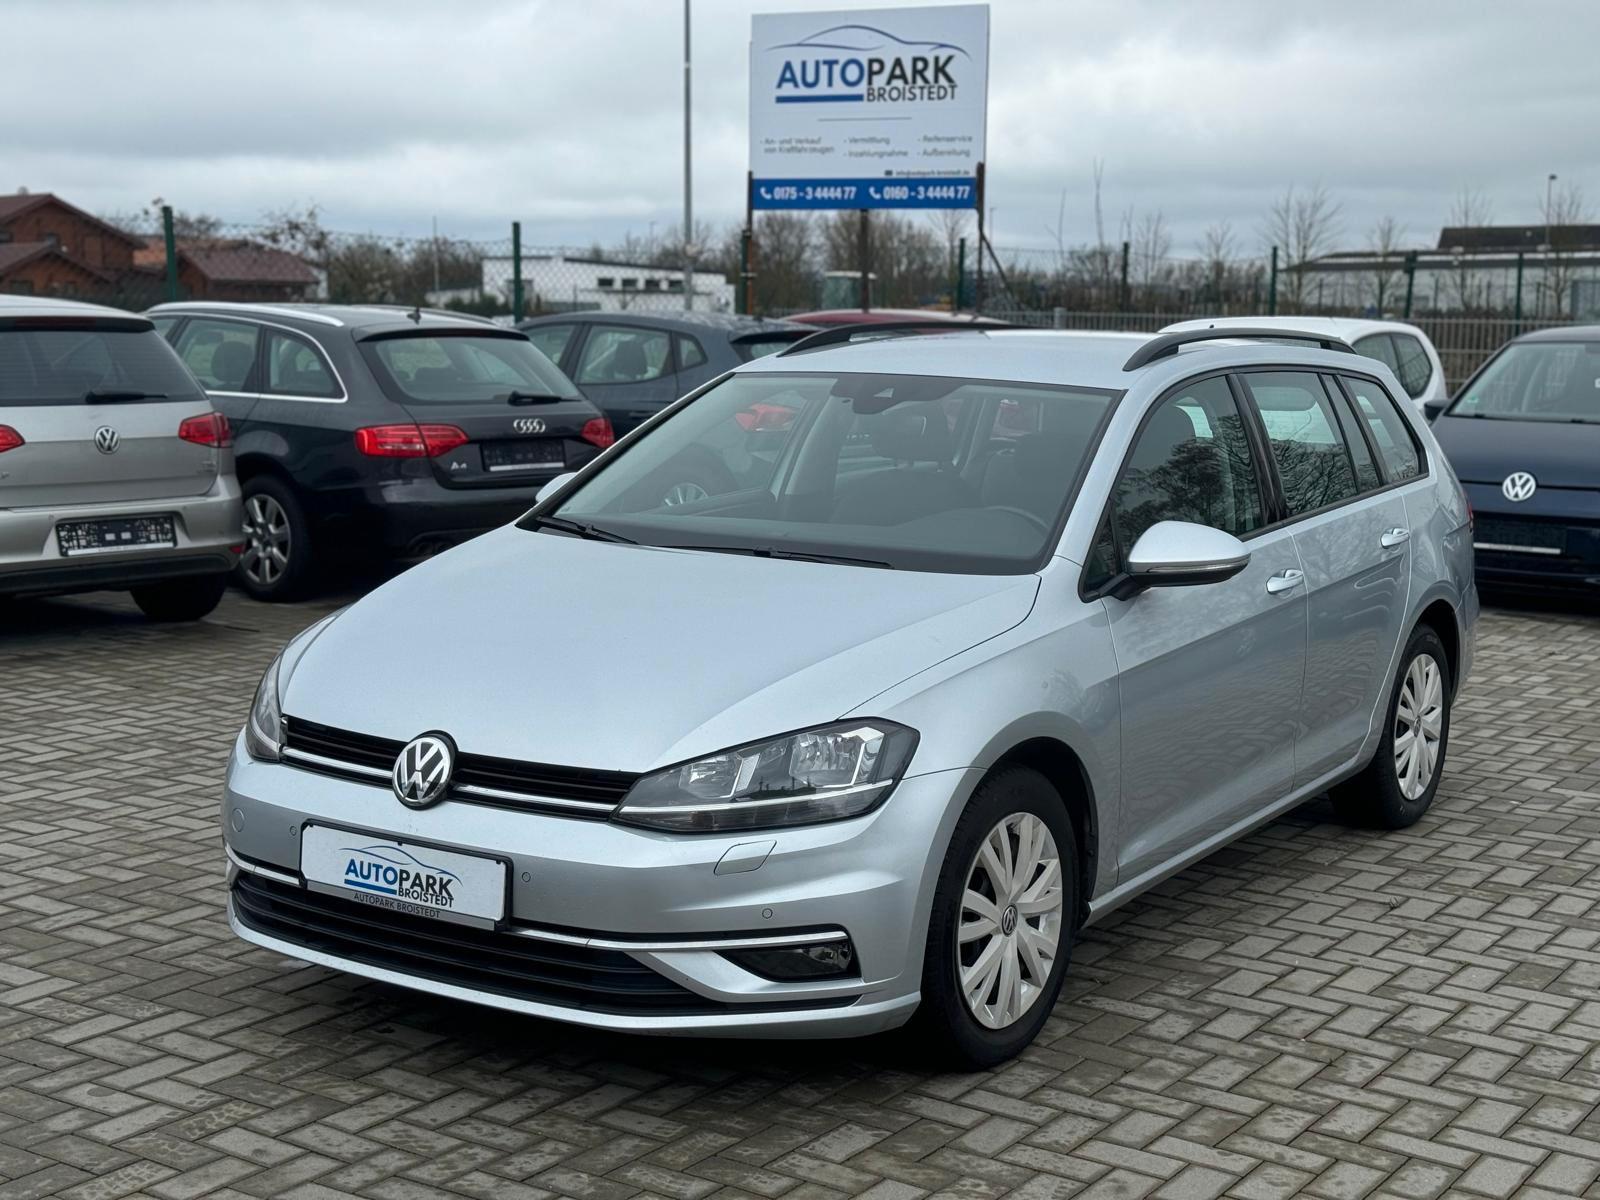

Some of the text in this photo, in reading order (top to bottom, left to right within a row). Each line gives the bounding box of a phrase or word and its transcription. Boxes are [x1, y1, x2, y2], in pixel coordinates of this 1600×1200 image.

[775, 54, 956, 89] AUTOPARK
[866, 84, 958, 102] BROISTEDT
[773, 186, 798, 200] 0175
[345, 858, 453, 899] AUTOPARK
[353, 892, 441, 919] AUTOPARK BROISTEDT
[398, 886, 455, 908] BROISTEDT
